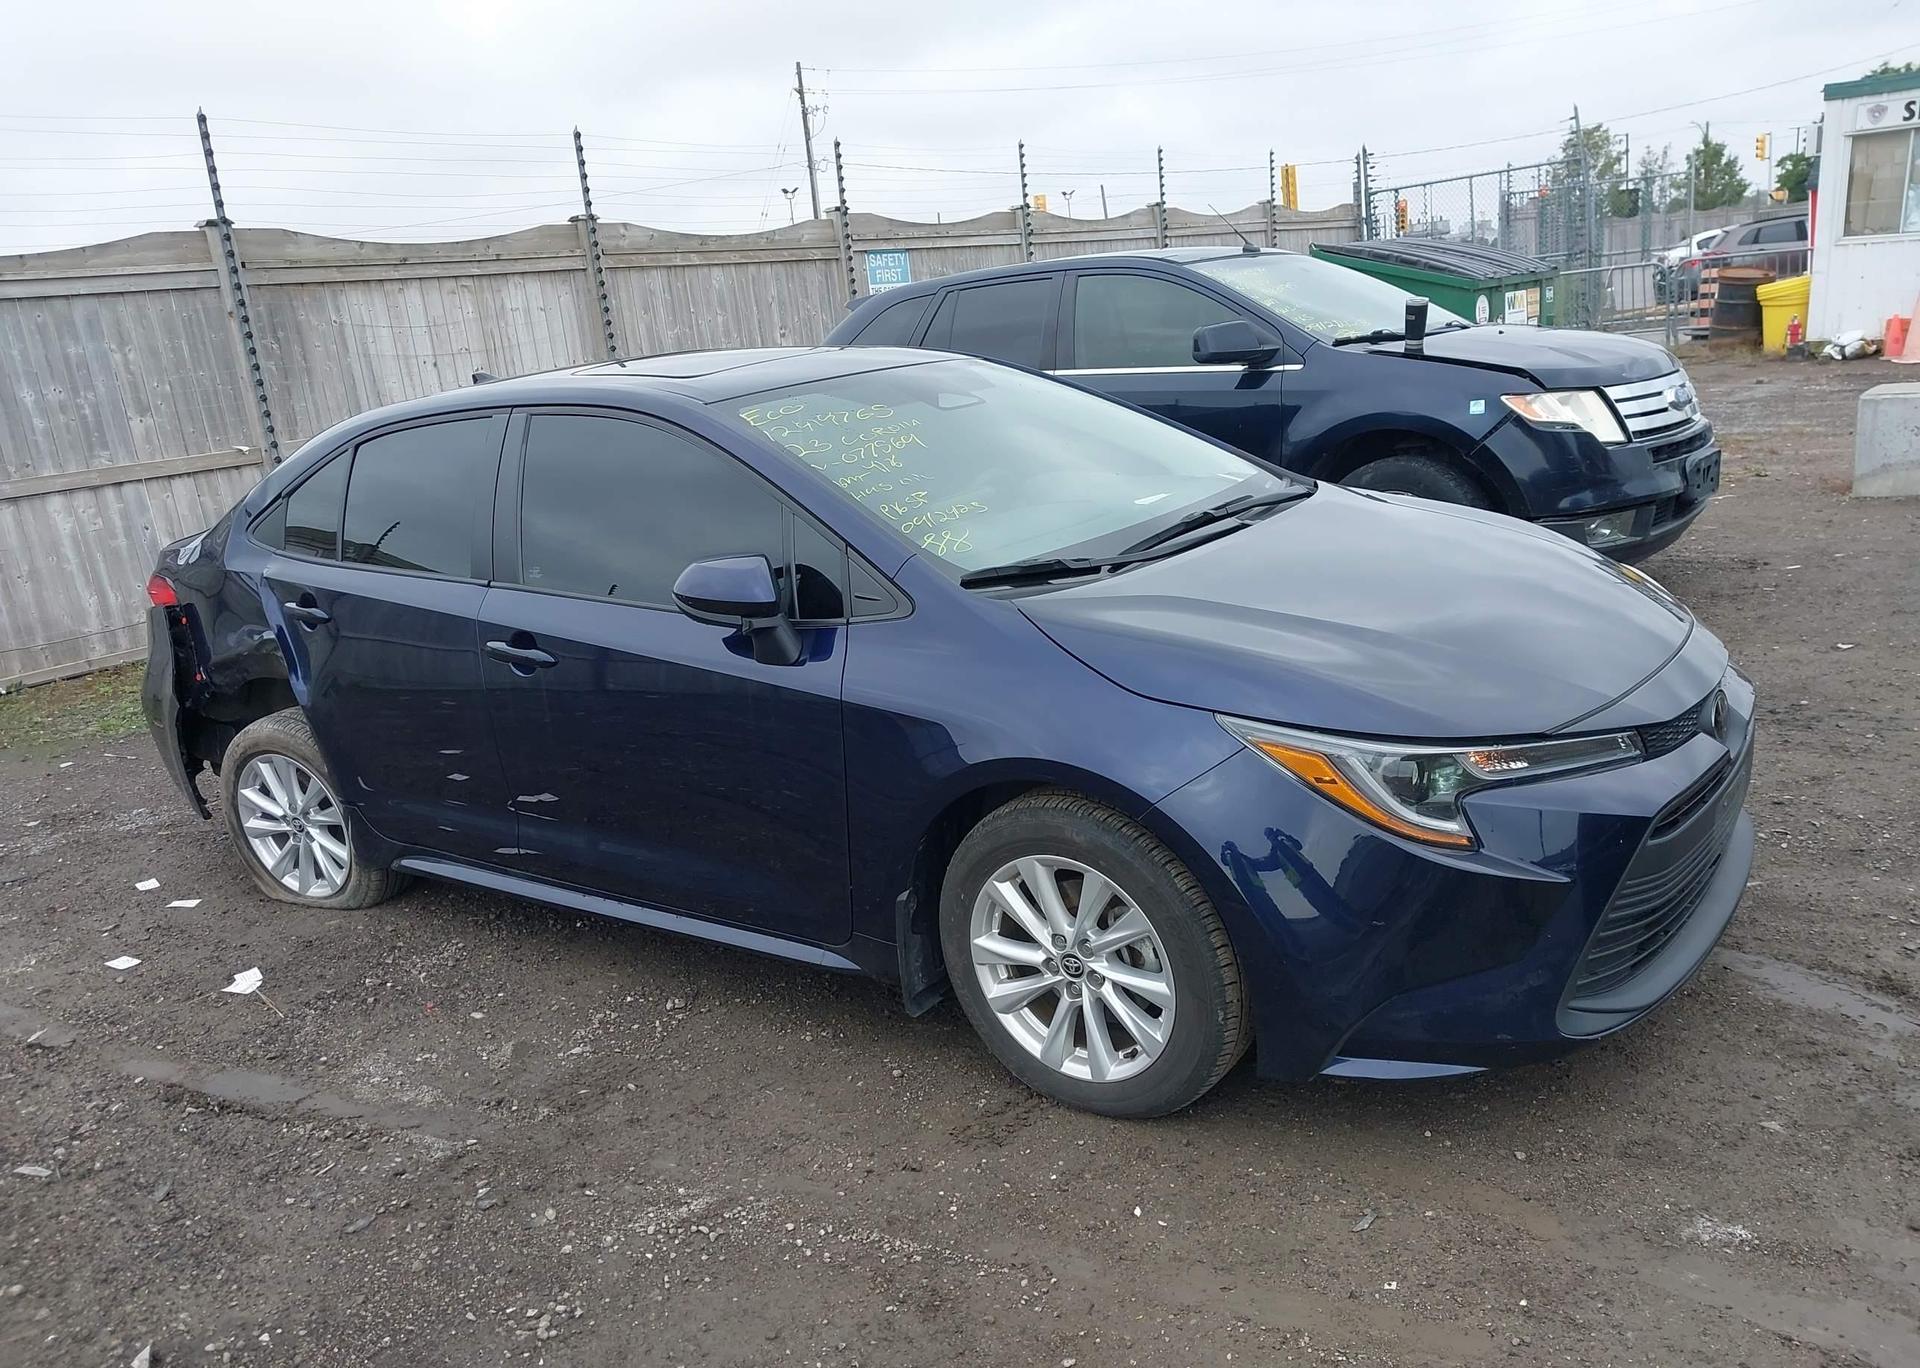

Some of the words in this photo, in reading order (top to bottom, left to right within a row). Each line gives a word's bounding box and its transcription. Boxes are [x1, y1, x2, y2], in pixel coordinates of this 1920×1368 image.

[1902, 99, 1920, 121] S
[868, 253, 905, 267] SAFETY
[876, 268, 902, 283] FIRST
[1507, 292, 1526, 311] WM
[785, 439, 833, 457] 23
